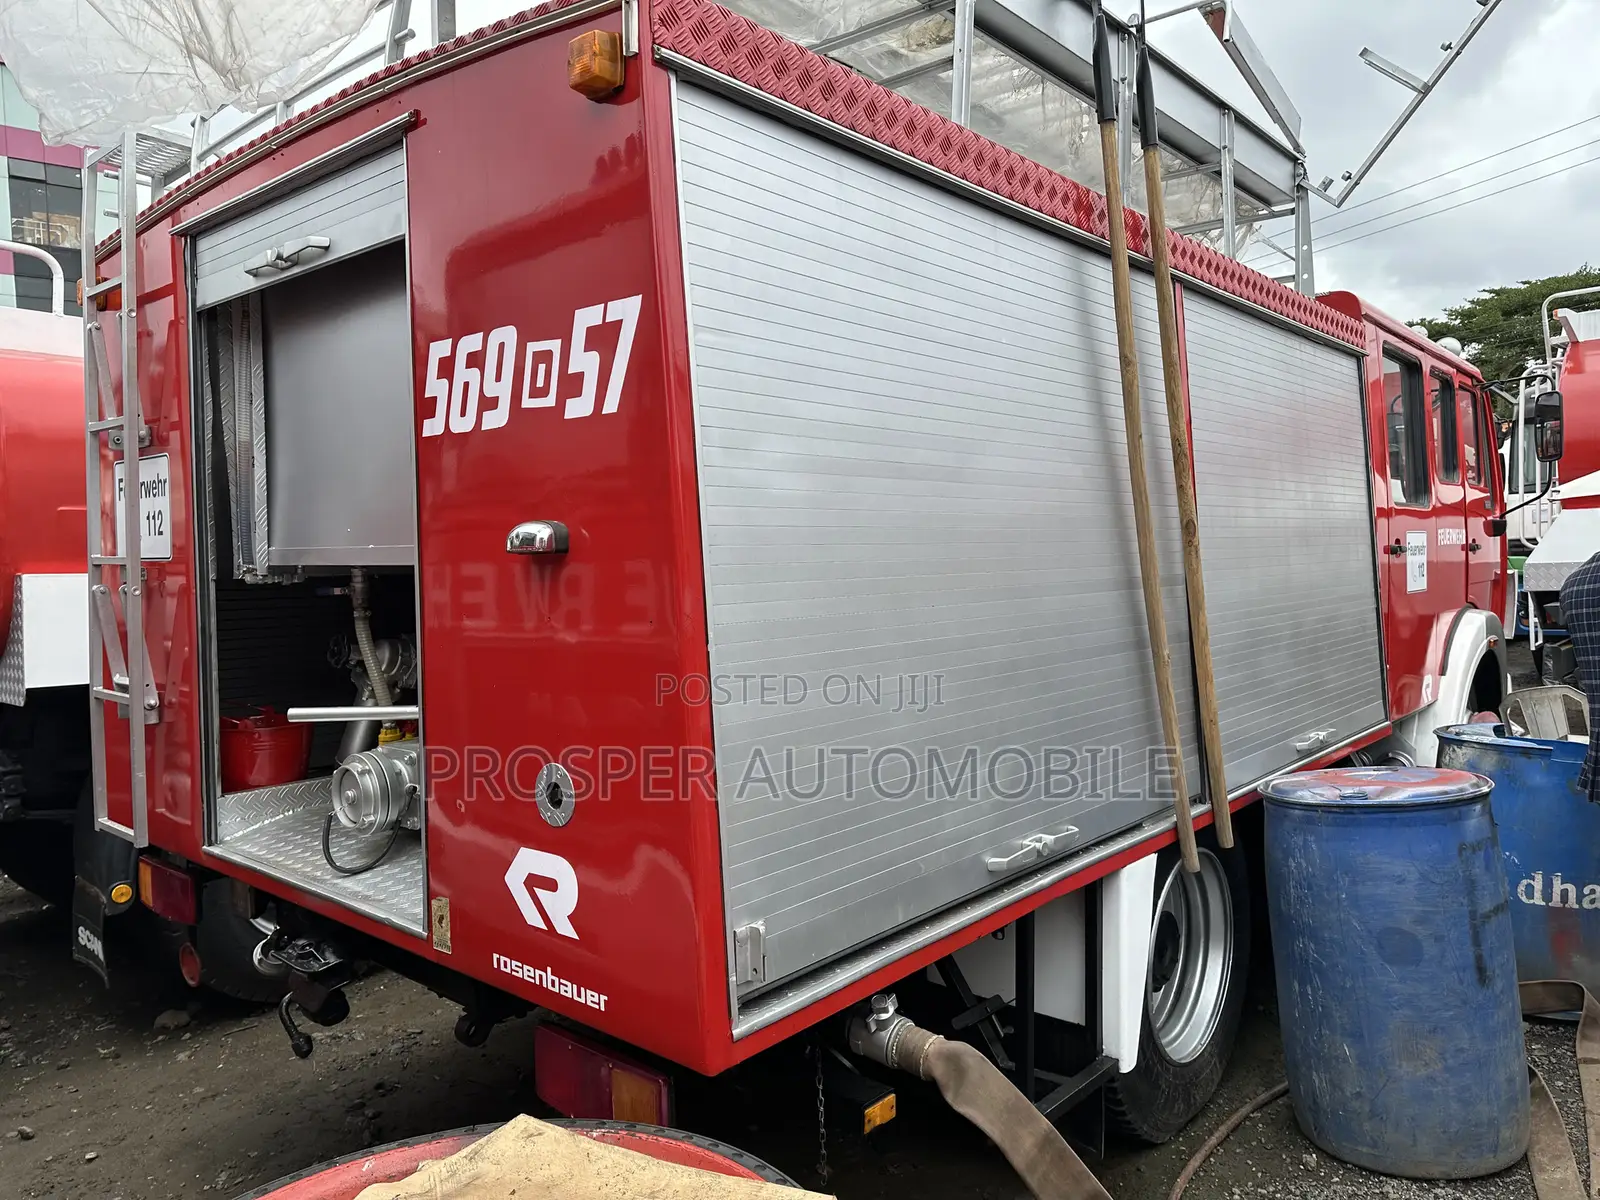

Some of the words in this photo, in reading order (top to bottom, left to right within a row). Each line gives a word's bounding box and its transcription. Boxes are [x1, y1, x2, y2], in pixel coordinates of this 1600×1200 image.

[563, 294, 643, 420] 57
[117, 472, 168, 501] Frwehr
[146, 509, 164, 536] 112
[492, 952, 609, 1013] rosenbauer
